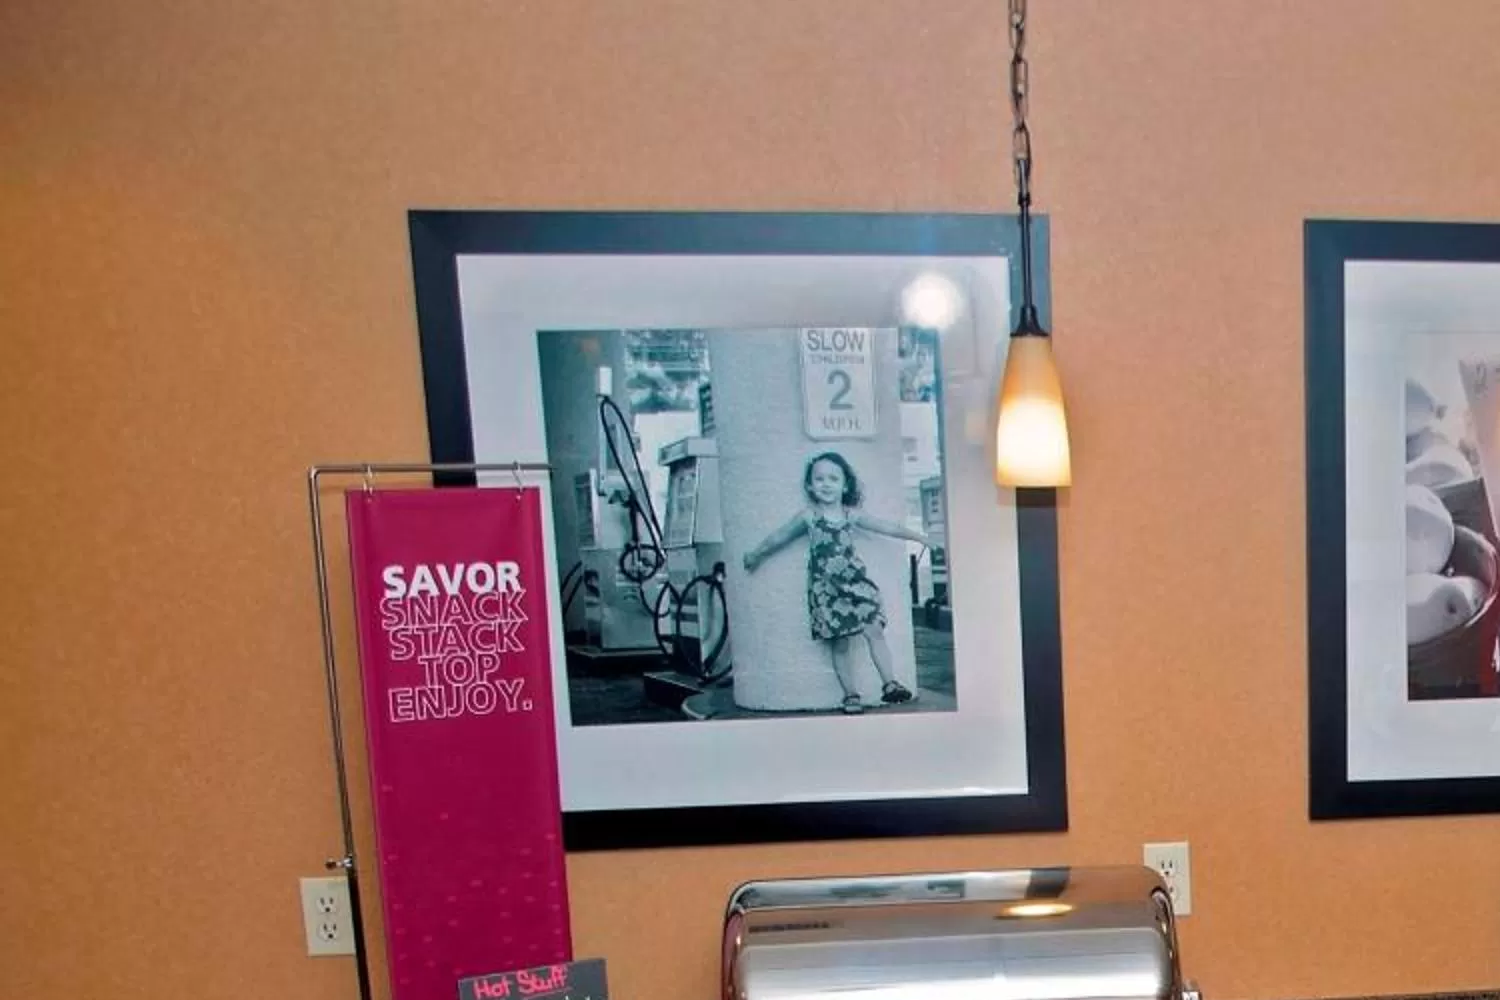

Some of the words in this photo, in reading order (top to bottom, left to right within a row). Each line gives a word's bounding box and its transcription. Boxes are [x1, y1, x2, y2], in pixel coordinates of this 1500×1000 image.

[807, 329, 865, 352] SLOW
[827, 369, 855, 411] 2
[382, 560, 522, 599] SAVOR
[380, 589, 529, 631] SNACK
[389, 620, 525, 661] STACK
[418, 652, 501, 689] TOP
[388, 678, 533, 723] ENJOY.
[473, 974, 513, 1000] Hot
[516, 964, 568, 994] Stuff
